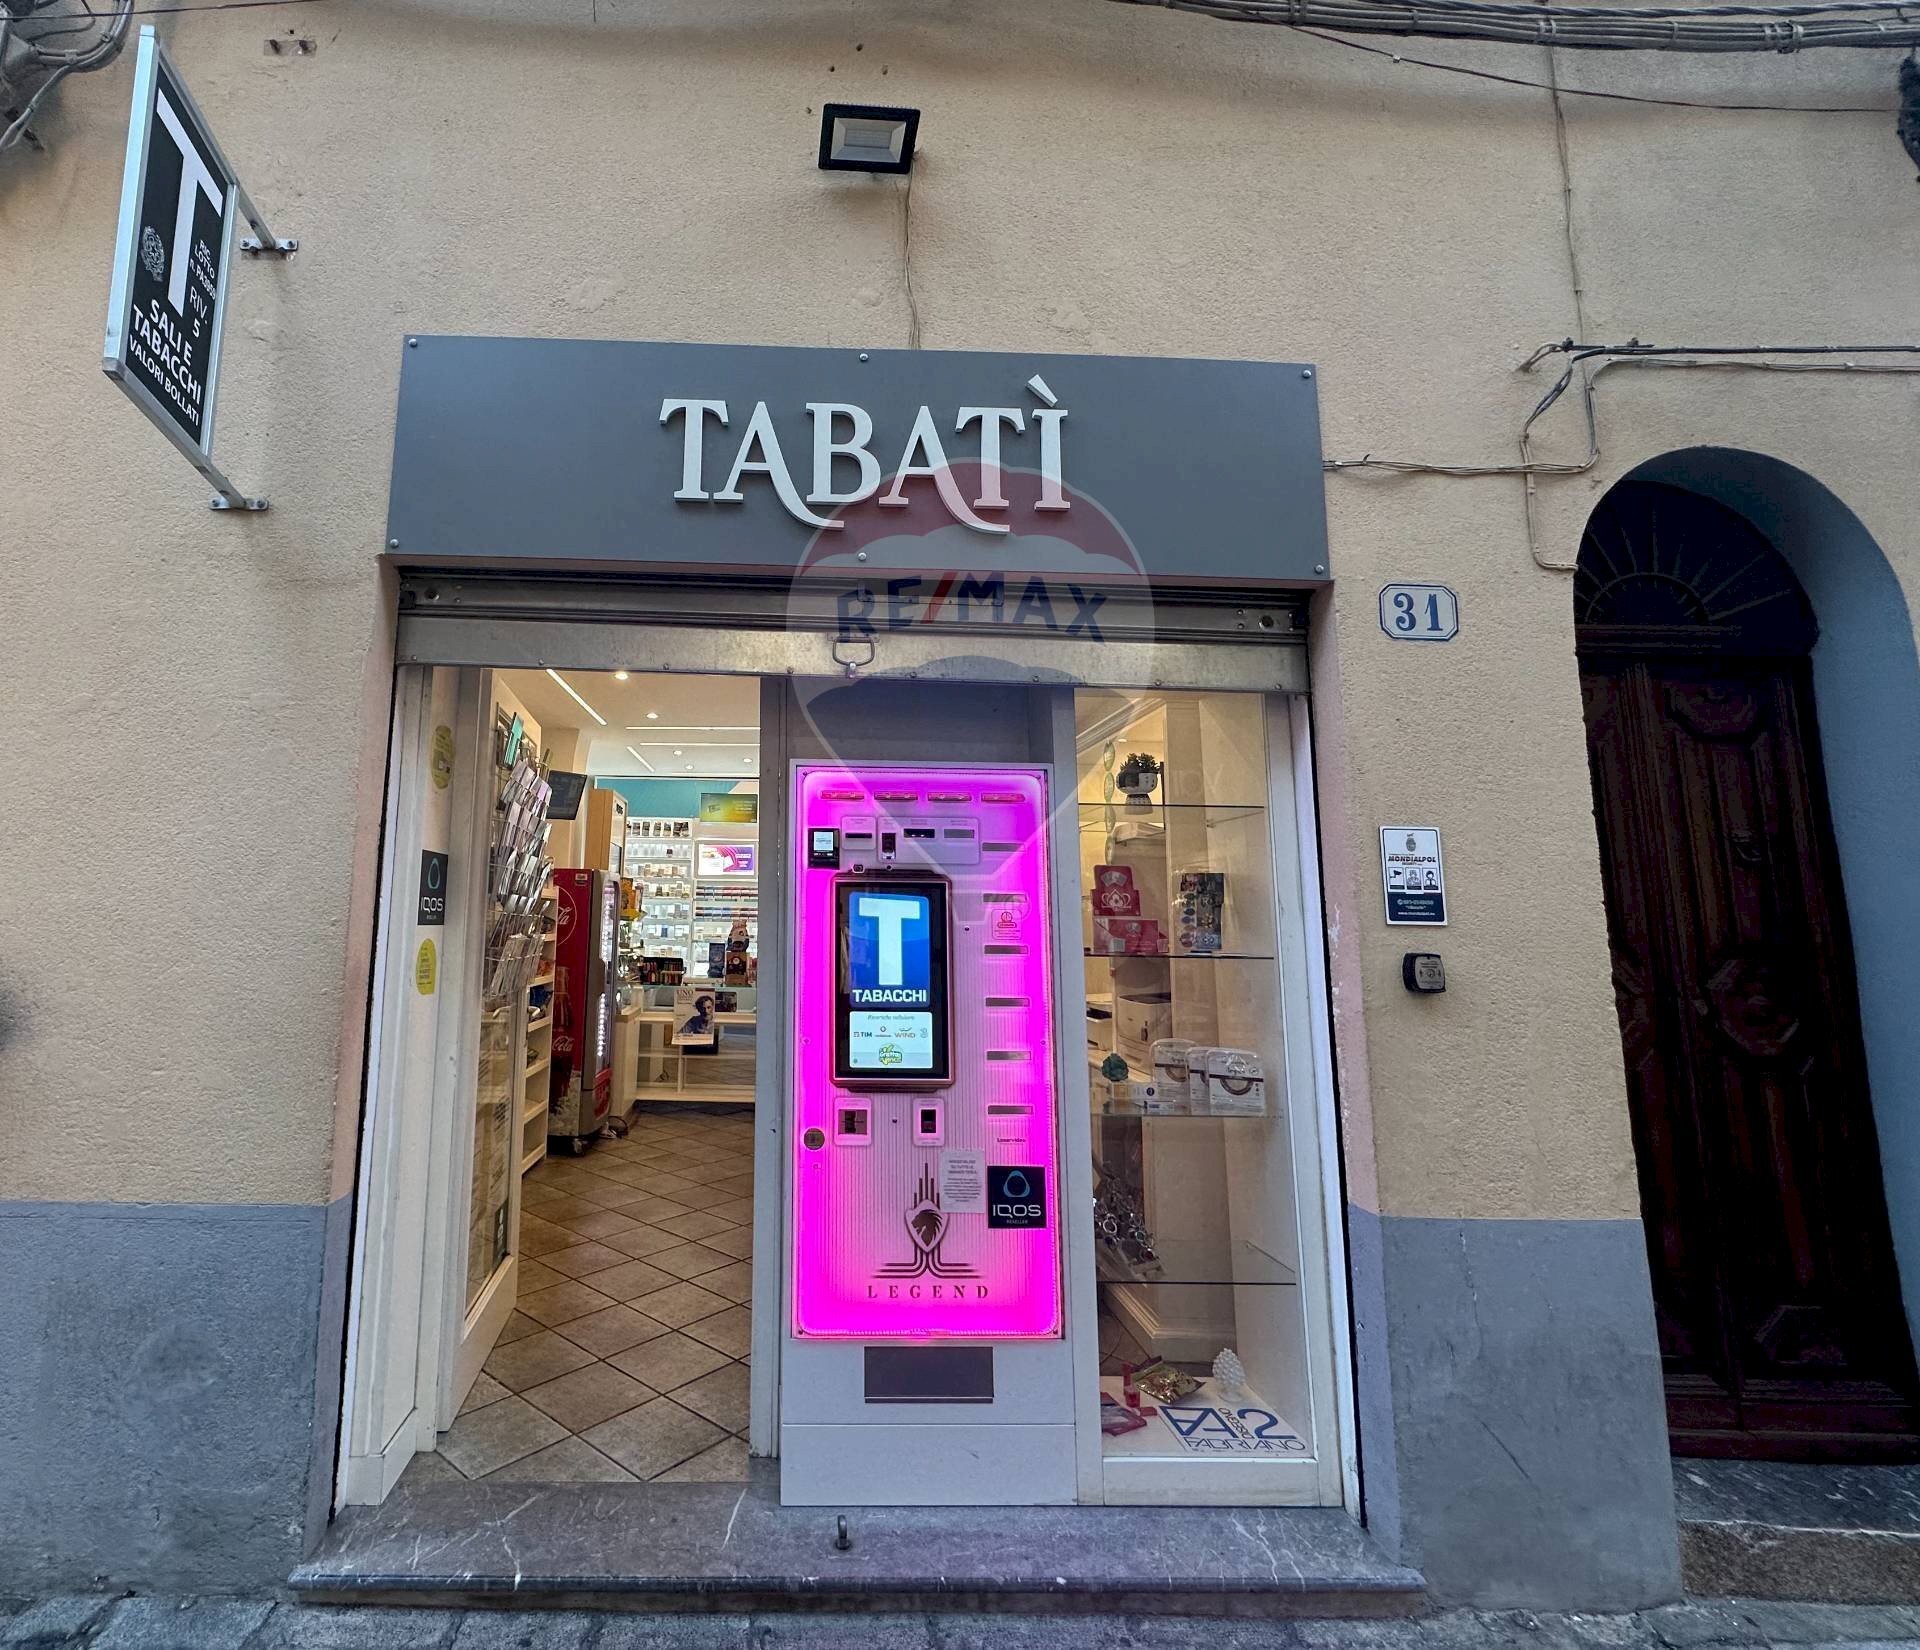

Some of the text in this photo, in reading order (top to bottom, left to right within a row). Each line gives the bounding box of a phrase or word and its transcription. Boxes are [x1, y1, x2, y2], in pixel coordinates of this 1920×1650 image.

[157, 88, 223, 317] T
[194, 244, 215, 279] LOTTO
[189, 286, 208, 324] RIV.
[150, 299, 193, 366] SALI E
[193, 318, 200, 338] 5
[133, 304, 201, 404] TABACCHI
[129, 334, 199, 426] VALORI BOLLATI
[659, 374, 1071, 534] TABATÌ
[1394, 592, 1443, 631] 31
[420, 896, 444, 914] IQOS
[859, 897, 920, 985] T
[852, 989, 927, 1003] TABACCHI
[992, 1204, 1042, 1218] IQOS
[867, 1285, 989, 1299] LEGEND
[1183, 1437, 1306, 1451] FABRIANO
